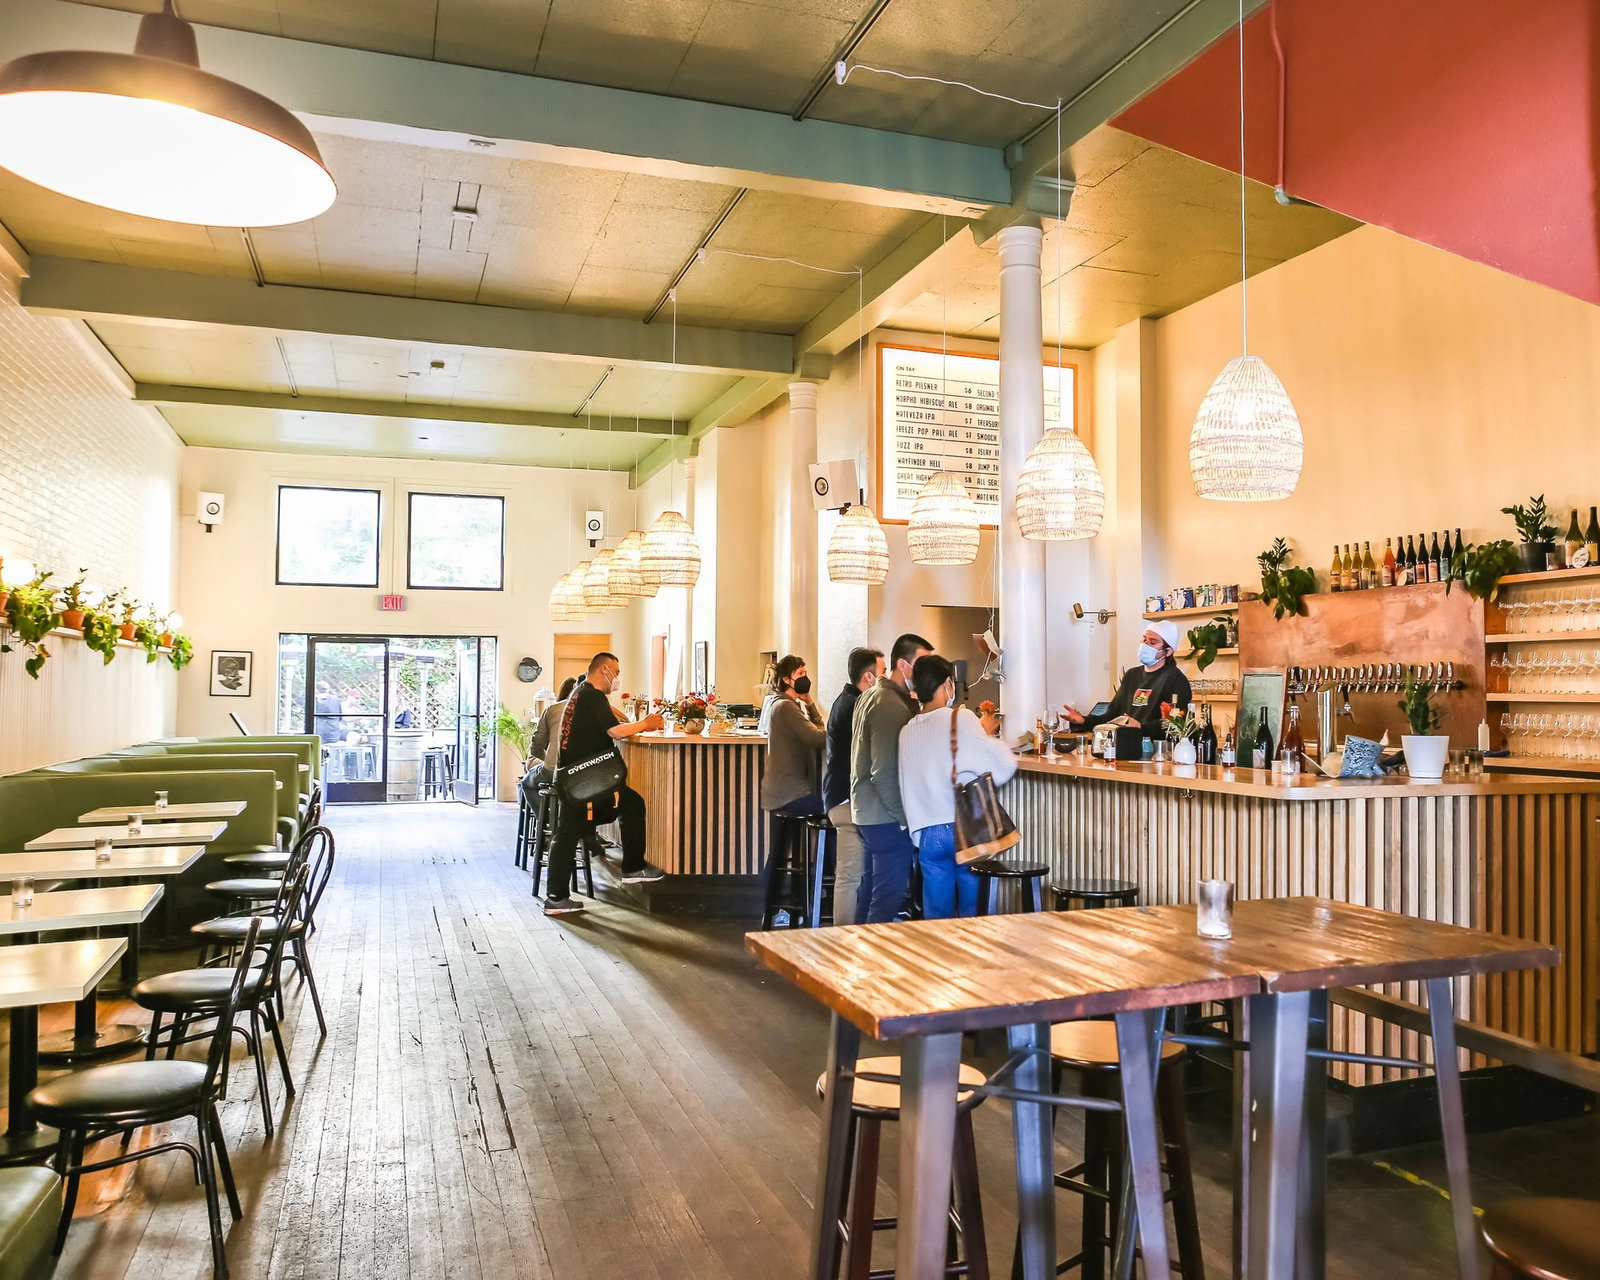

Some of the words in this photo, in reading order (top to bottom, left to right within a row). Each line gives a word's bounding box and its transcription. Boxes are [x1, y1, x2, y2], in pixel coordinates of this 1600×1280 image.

[896, 380, 912, 388] RETRO
[915, 382, 938, 390] PILSNER
[977, 389, 995, 397] SECOND
[896, 395, 916, 404] MORPHO
[920, 398, 944, 407] HIBISCUS
[896, 411, 923, 419] MATEVEZA
[977, 419, 999, 428] TREASUR
[896, 425, 914, 434] FREEZE
[977, 433, 997, 441] SMOOCH
[897, 441, 910, 450] FUZZ
[898, 458, 926, 466] WAYFINDER
[382, 596, 403, 610] EXIT
[568, 752, 615, 775] OVERWATCH
